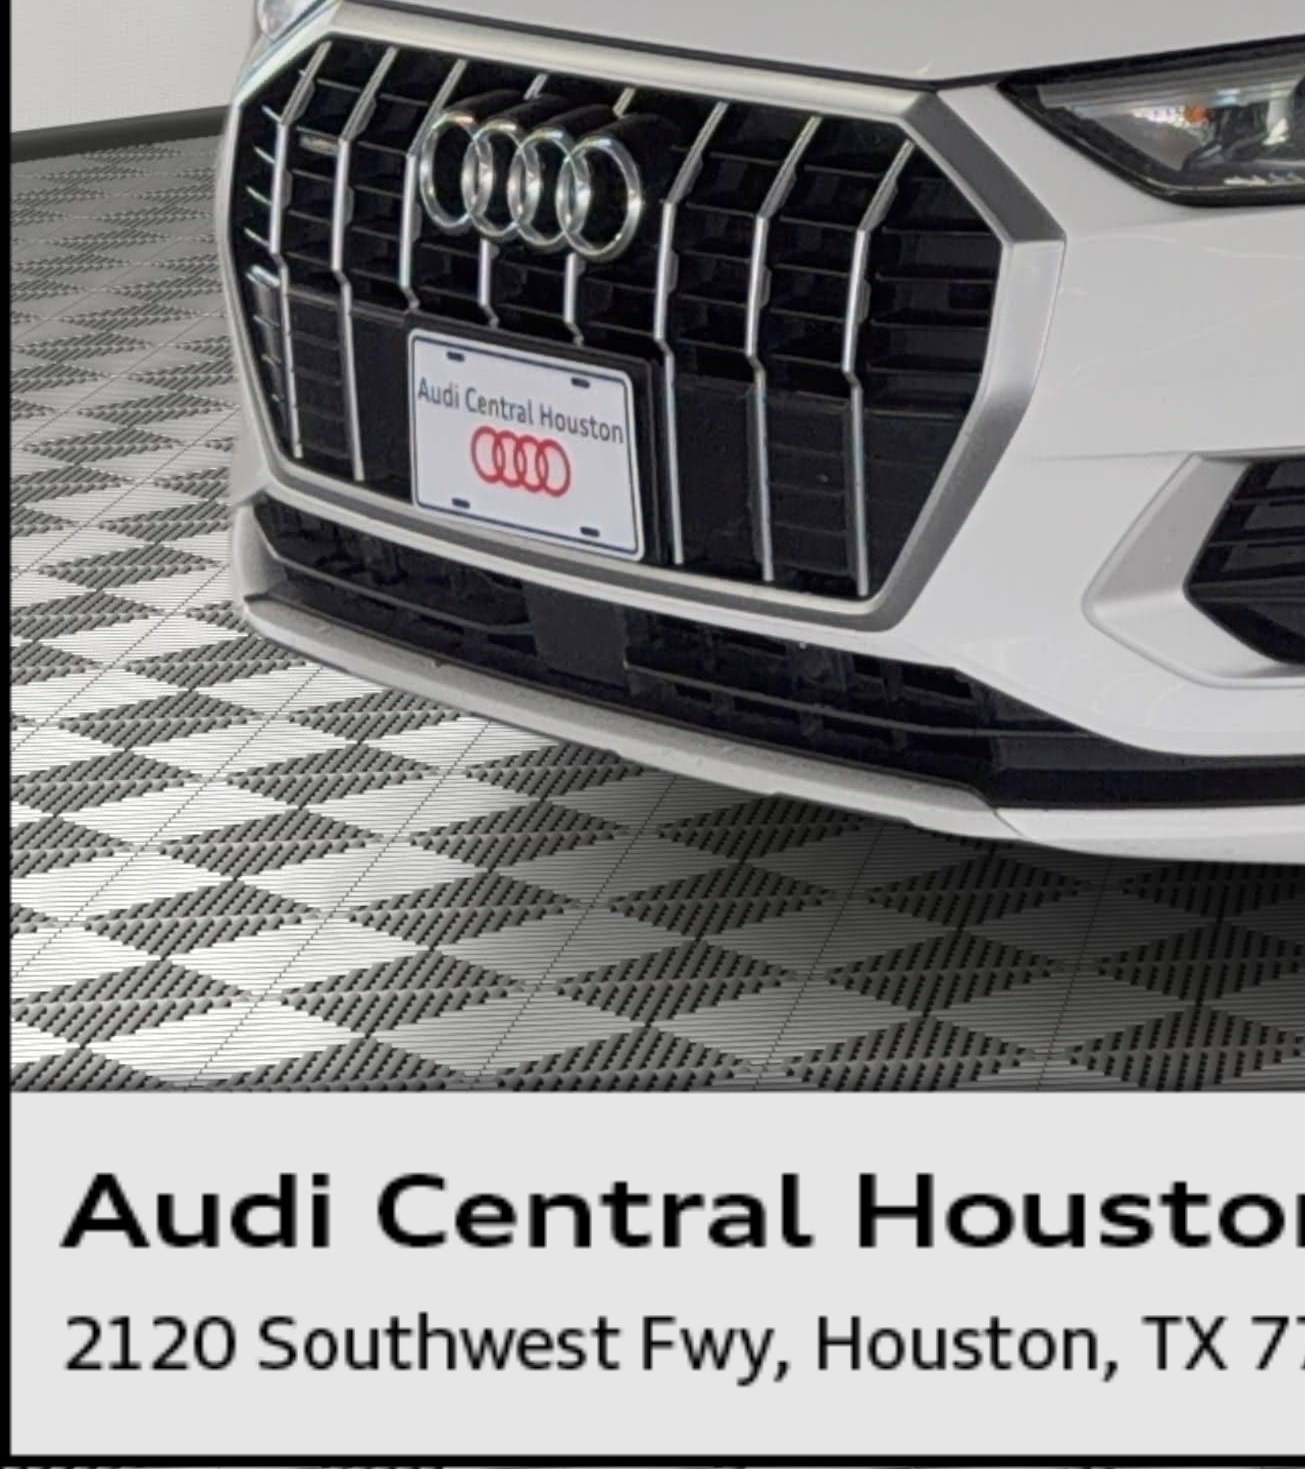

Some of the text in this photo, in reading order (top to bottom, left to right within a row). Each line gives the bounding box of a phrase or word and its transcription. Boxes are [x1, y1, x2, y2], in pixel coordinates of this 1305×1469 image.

[417, 376, 625, 444] Audi Central Houston
